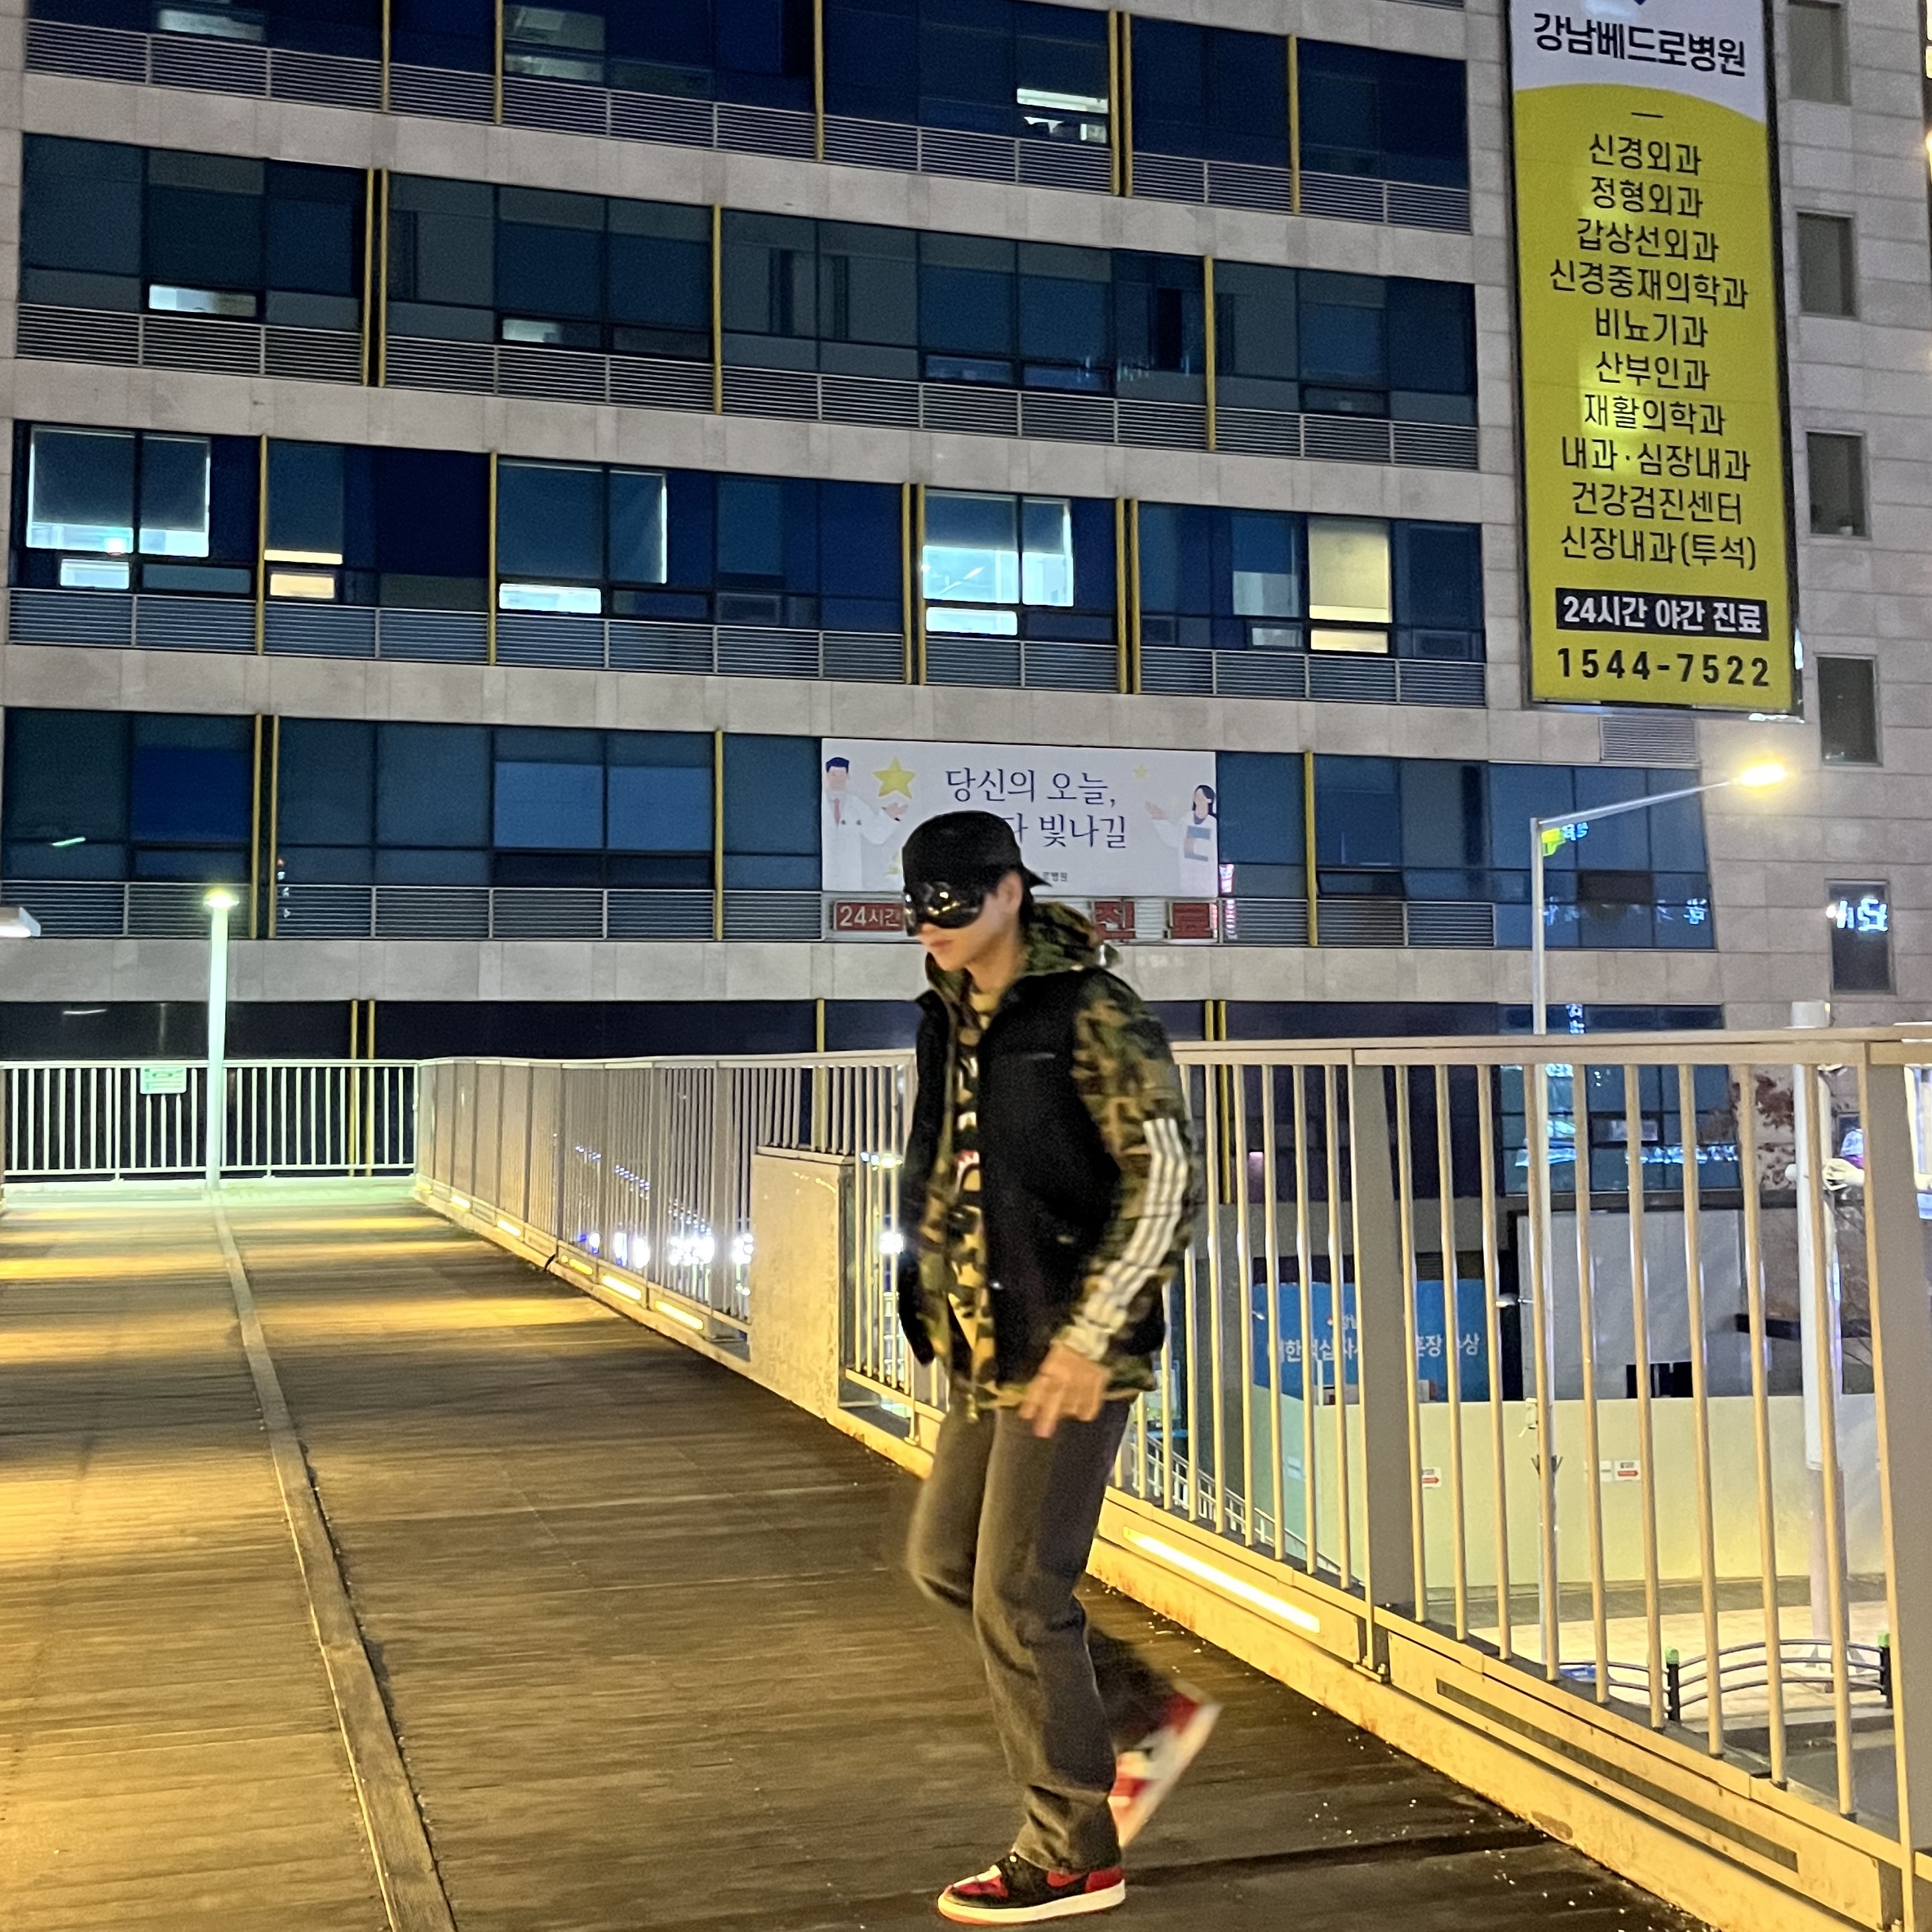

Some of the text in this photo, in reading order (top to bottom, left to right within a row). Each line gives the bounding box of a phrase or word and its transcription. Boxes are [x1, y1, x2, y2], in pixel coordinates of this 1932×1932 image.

[1533, 13, 1746, 77] 강남베드로병원
[1589, 133, 1703, 176] 신경외과
[1591, 176, 1704, 219] 정형외과
[1577, 219, 1719, 263] 갑상선외과
[1550, 259, 1750, 309] 신경중재의학과
[1595, 307, 1709, 348] 비뇨기과
[1595, 351, 1711, 392] 산부인과
[1584, 394, 1727, 437] 재활의학과
[1572, 482, 1743, 525] 건강검진센터
[1561, 526, 1757, 570] 신장내과(투석)
[1562, 596, 1762, 634] 24시간 야간 진료
[1557, 647, 1770, 687] 1544-7522
[945, 767, 1116, 807] 당신의 오늘,
[1039, 814, 1126, 849] 빛나길
